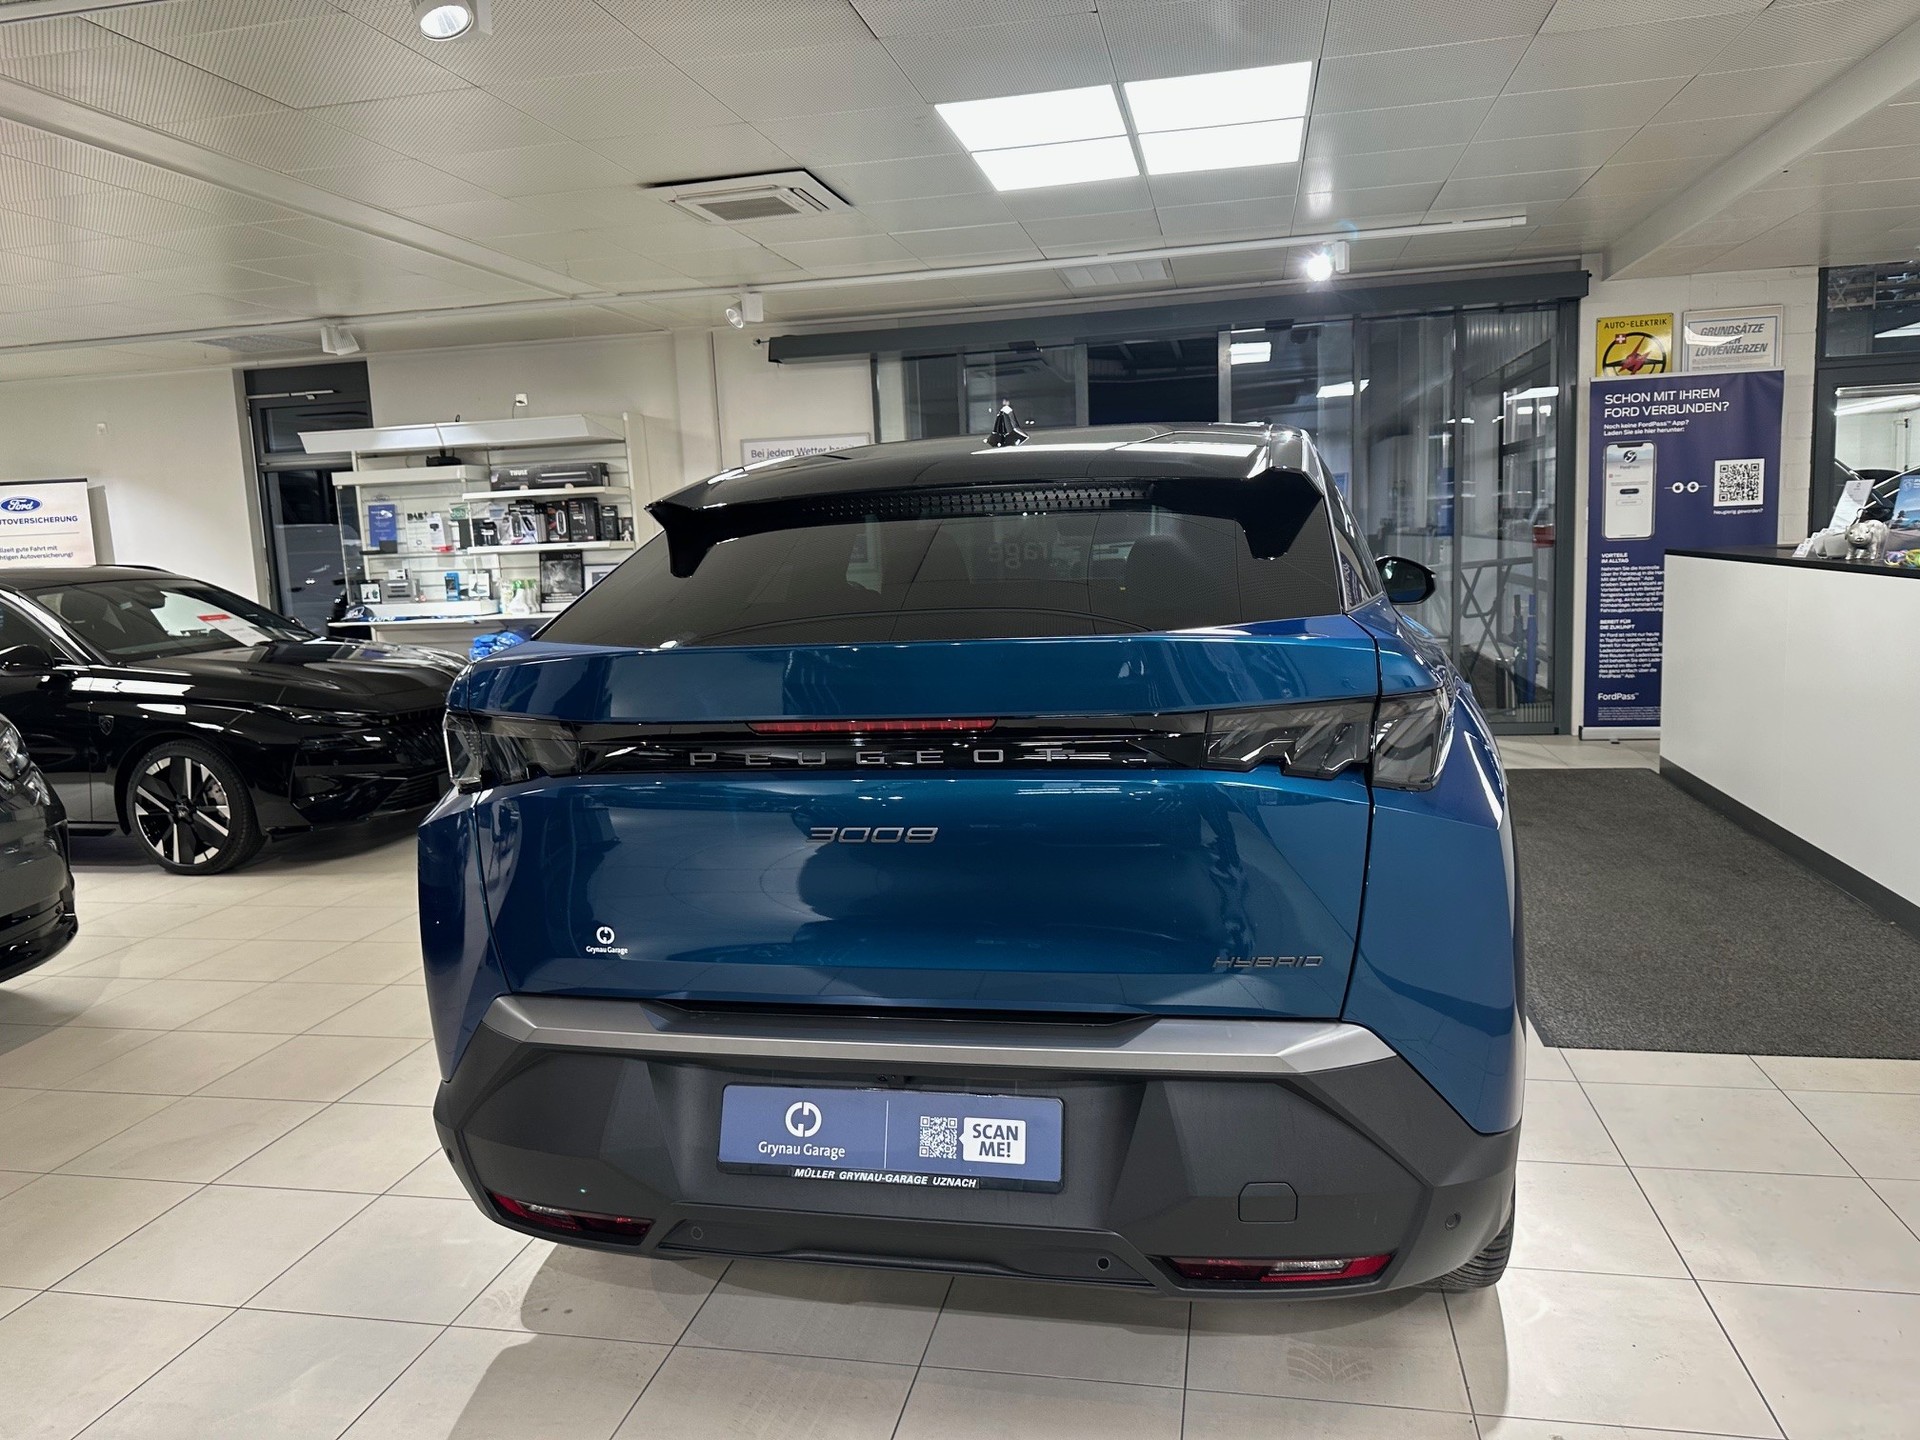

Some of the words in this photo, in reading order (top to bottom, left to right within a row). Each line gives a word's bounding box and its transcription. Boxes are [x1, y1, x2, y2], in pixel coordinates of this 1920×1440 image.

[1604, 319, 1667, 329] AUTO-ELEKTRIK
[1701, 322, 1765, 336] GRUNDSÄTZE
[1604, 392, 1650, 405] SCHON
[1653, 390, 1677, 402] MIT
[1679, 388, 1720, 400] IHREM
[1604, 406, 1640, 418] FORD
[1642, 401, 1730, 416] VERBUNDEN?
[751, 449, 765, 458] Bei
[766, 448, 794, 459] jedem
[7, 499, 34, 511] Ford
[689, 748, 1063, 766] PEUGEOT
[807, 827, 938, 843] 3008
[1212, 955, 1323, 968] HYBRID
[972, 1123, 1019, 1141] SCAN
[758, 1141, 801, 1157] Grynau
[803, 1143, 846, 1161] Garage
[979, 1141, 1012, 1158] ME!
[794, 1168, 836, 1179] MÜLLER
[838, 1171, 929, 1186] GRYNAU-GARAGE
[932, 1176, 977, 1188] UZNACH
